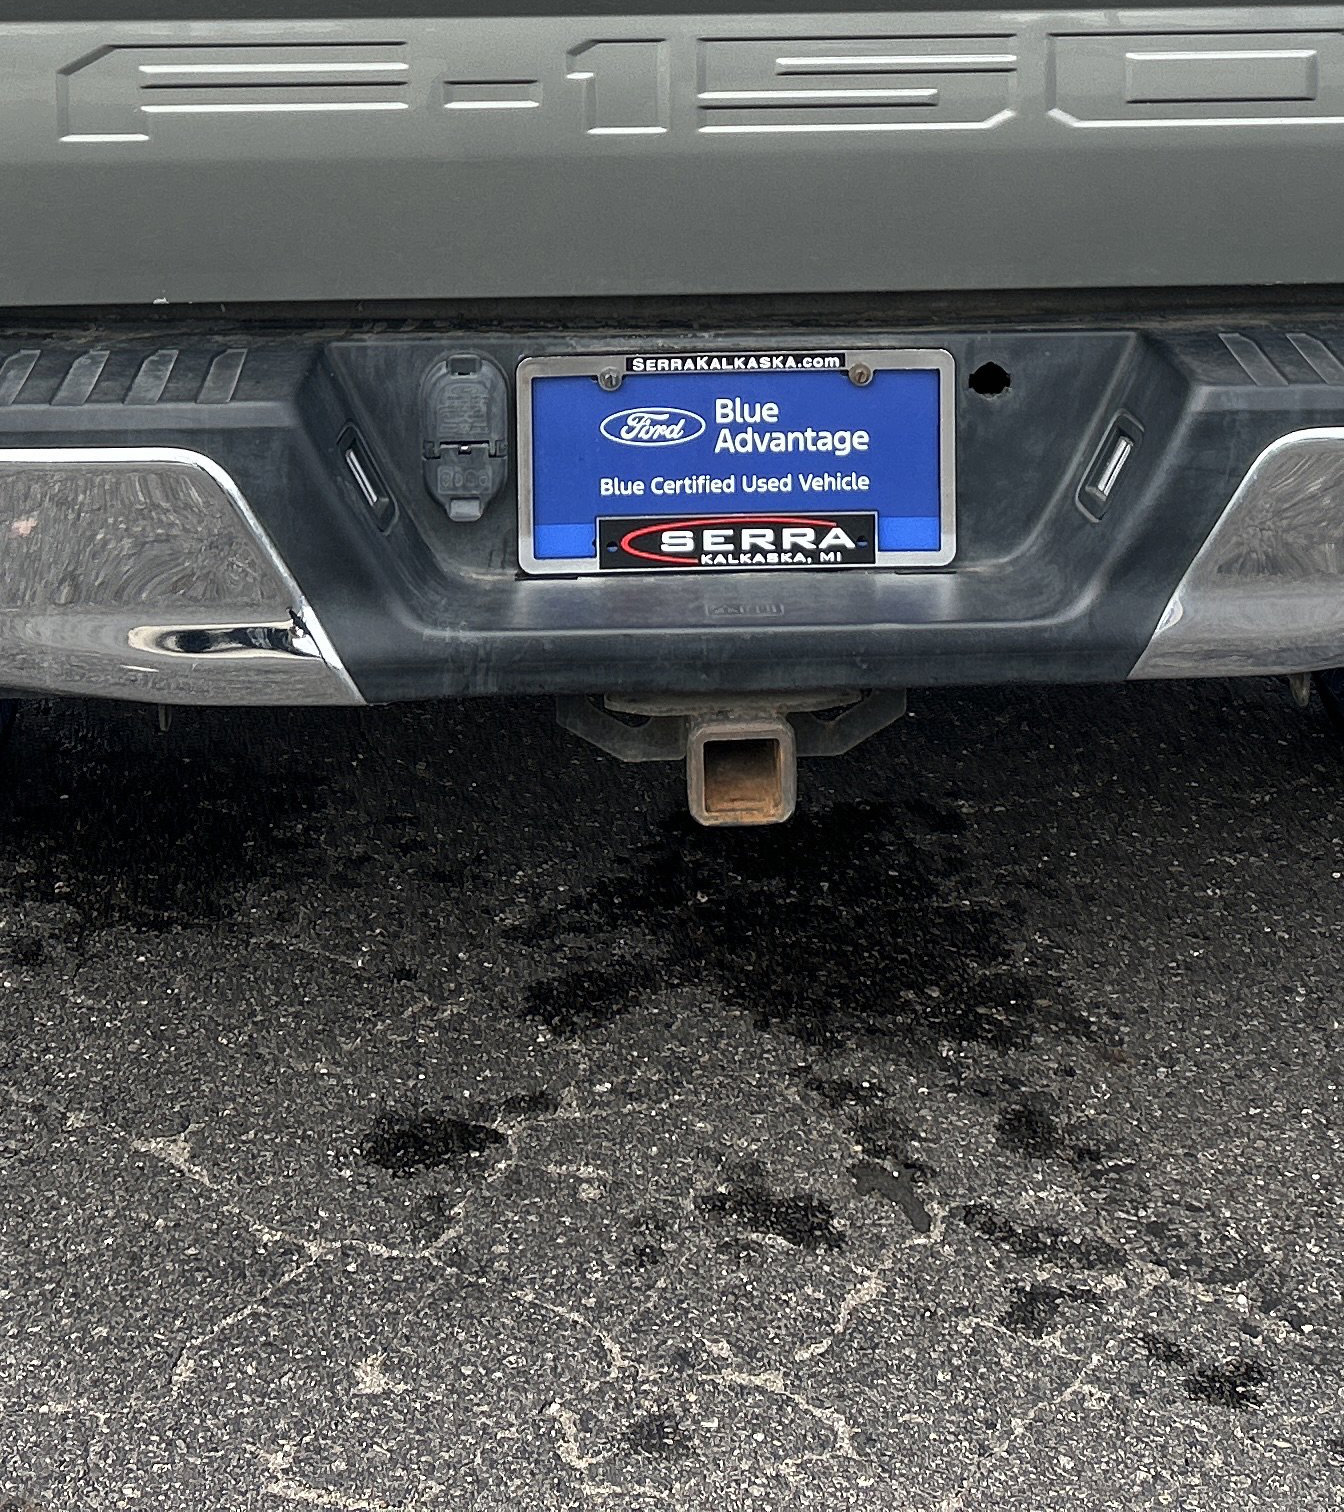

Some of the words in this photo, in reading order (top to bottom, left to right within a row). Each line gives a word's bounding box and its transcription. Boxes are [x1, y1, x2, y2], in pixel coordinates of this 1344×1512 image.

[715, 396, 779, 424] Blue
[619, 410, 685, 441] Ford
[714, 426, 870, 457] Advantage
[600, 476, 645, 496] Blue
[650, 474, 735, 495] Certified
[742, 473, 792, 493] Used
[798, 471, 870, 492] Vehicle
[660, 526, 856, 552] SERRA
[700, 551, 813, 565] KALKASKA,
[819, 550, 842, 563] MI
